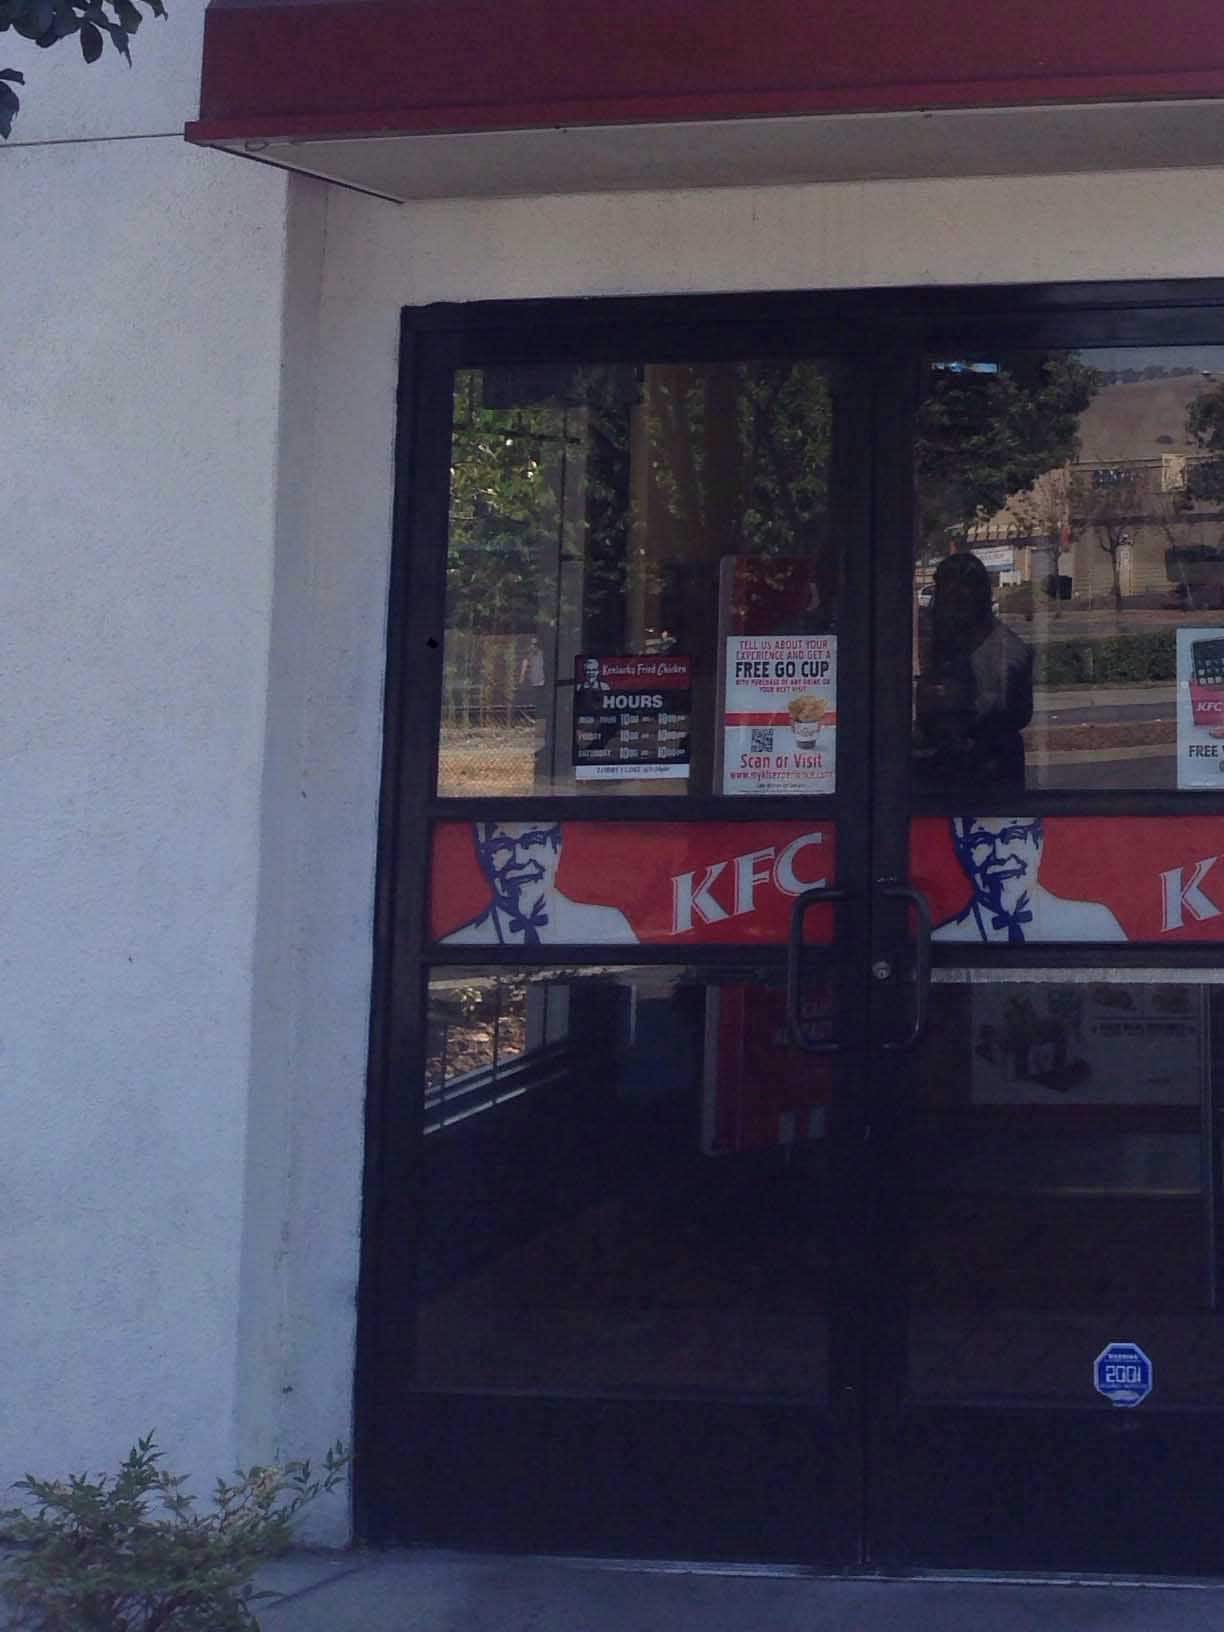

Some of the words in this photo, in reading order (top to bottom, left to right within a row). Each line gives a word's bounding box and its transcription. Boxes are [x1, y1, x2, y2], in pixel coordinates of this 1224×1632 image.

[740, 640, 758, 649] TELL
[761, 640, 772, 649] US
[775, 640, 802, 649] ABOUT
[806, 640, 828, 649] YOUR
[736, 651, 784, 660] EXPERIENCE
[787, 651, 804, 660] AND
[808, 650, 823, 659] GET
[637, 663, 656, 675] Fried
[736, 661, 769, 678] FREE
[774, 661, 796, 678] GO
[801, 661, 829, 678] CUP
[603, 695, 664, 708] HOURS
[1196, 701, 1223, 712] KFC
[1189, 745, 1218, 757] FREE
[740, 754, 770, 768] Scan
[776, 756, 788, 768] or
[794, 754, 822, 768] Visit
[672, 832, 826, 935] KFC
